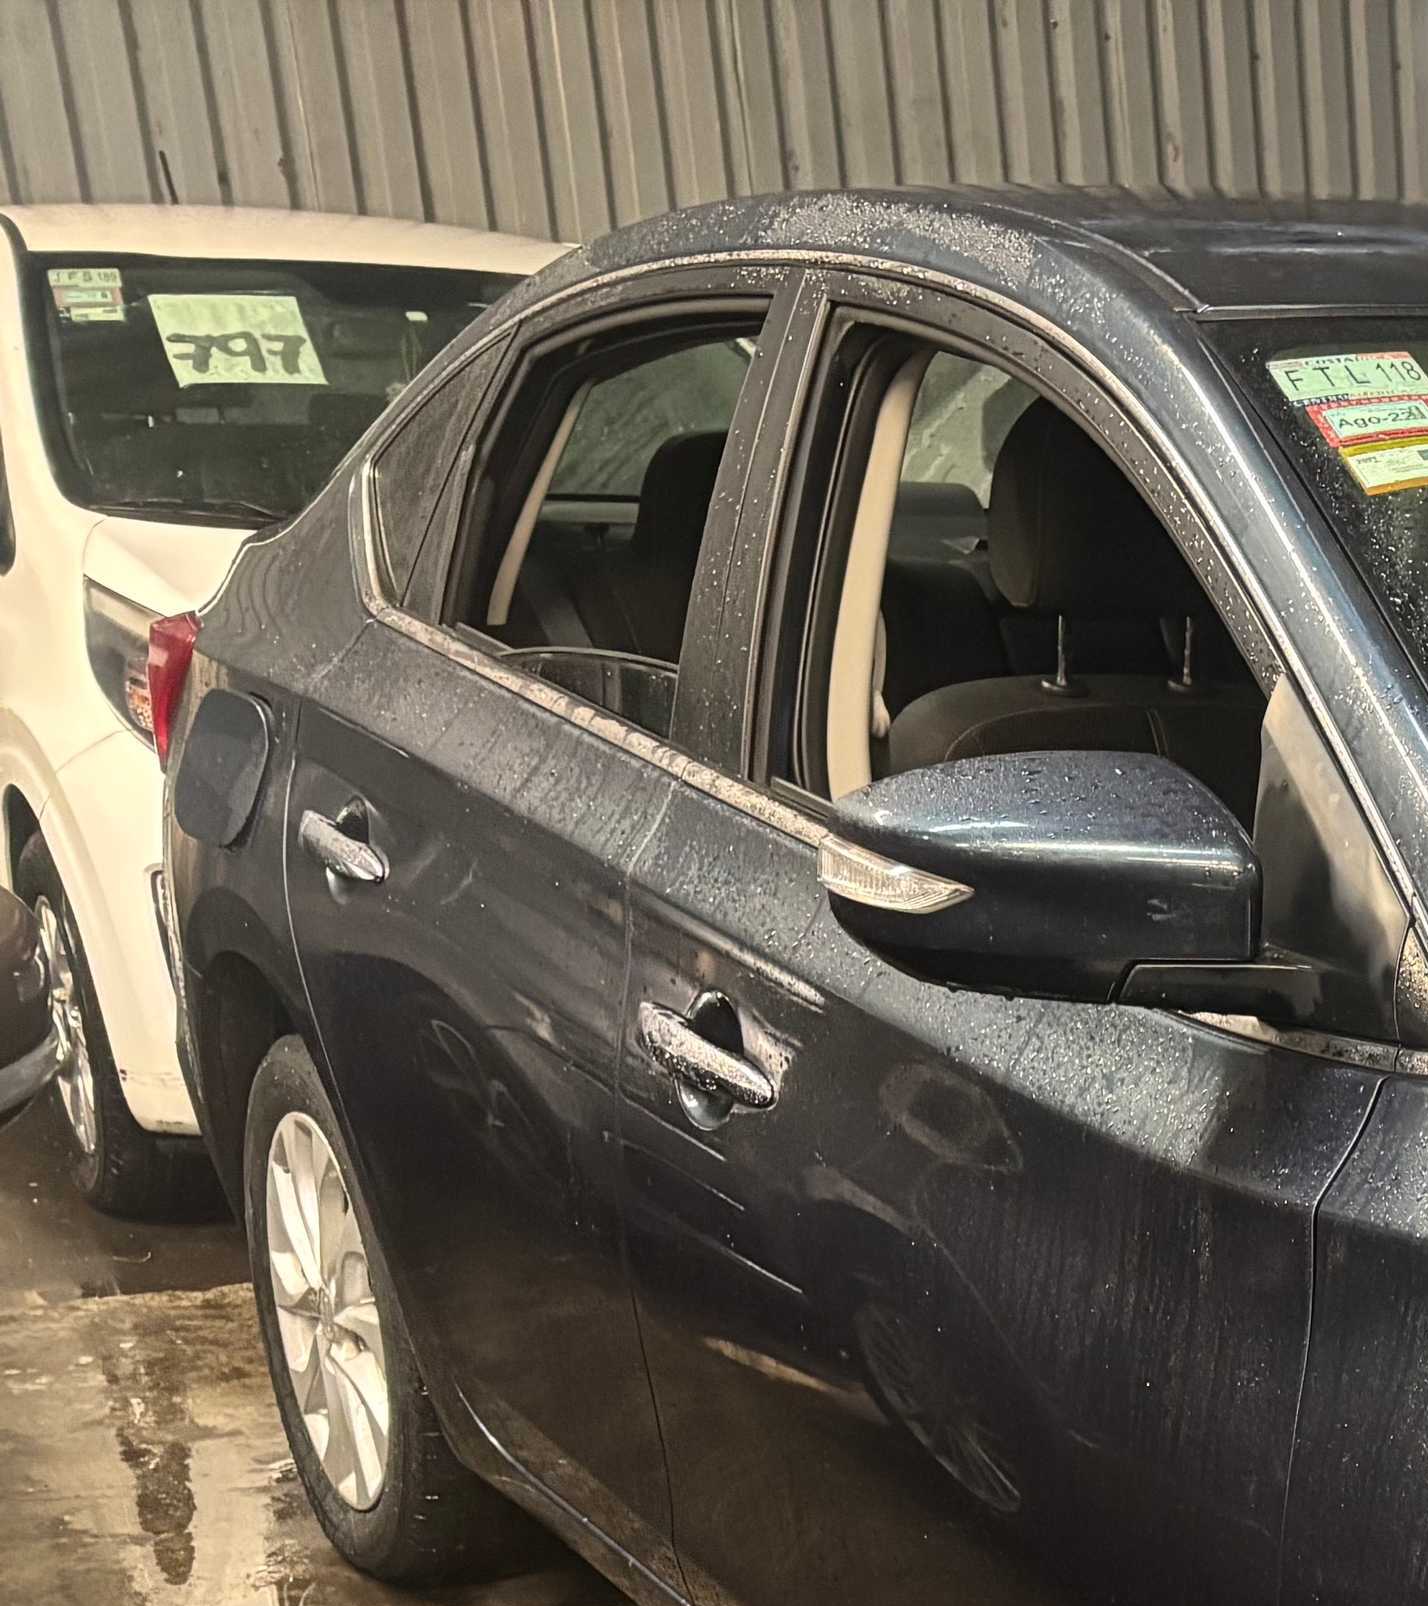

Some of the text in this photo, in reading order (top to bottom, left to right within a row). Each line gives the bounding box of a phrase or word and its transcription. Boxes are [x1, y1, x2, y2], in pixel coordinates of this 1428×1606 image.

[165, 331, 307, 376] 797
[1284, 360, 1422, 391] FTL 118
